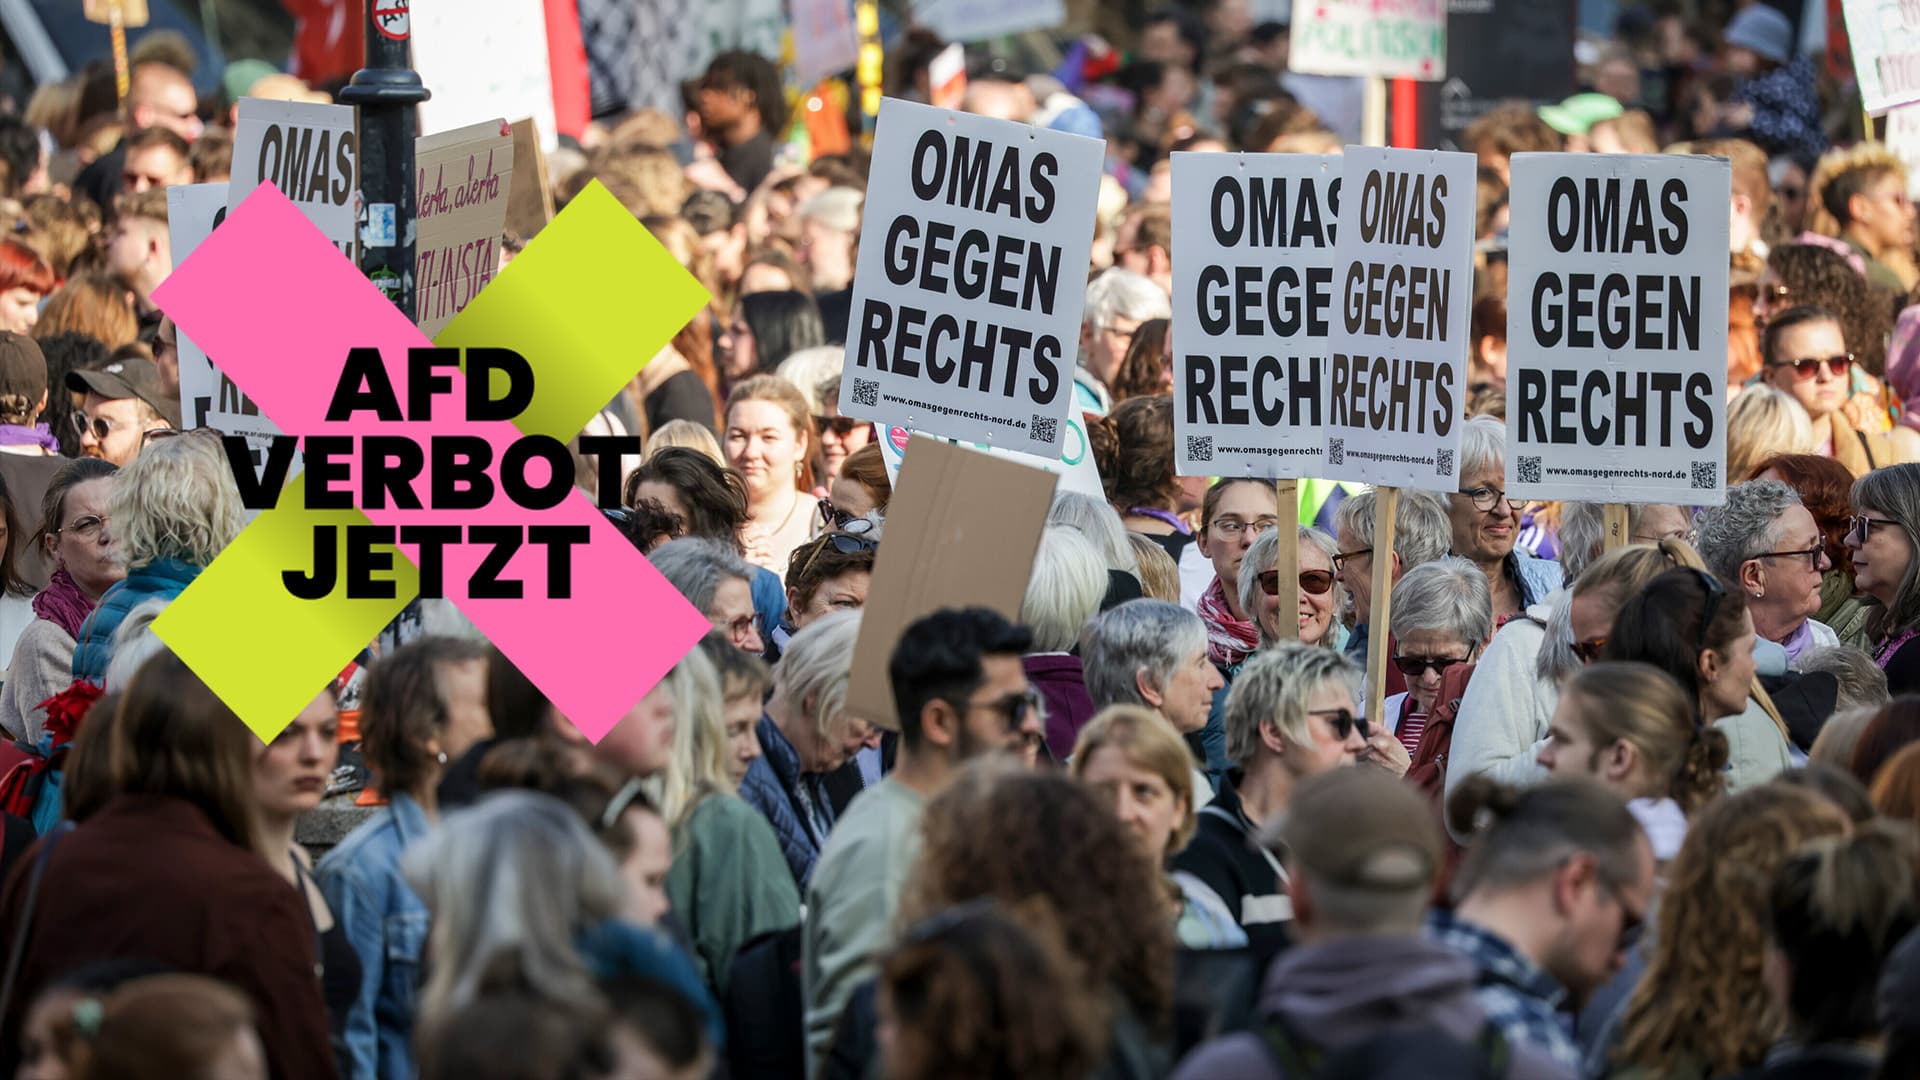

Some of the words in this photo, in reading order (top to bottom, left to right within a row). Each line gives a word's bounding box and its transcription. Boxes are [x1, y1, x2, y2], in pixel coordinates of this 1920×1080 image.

[257, 124, 355, 206] OMAS
[416, 164, 453, 220] lerta,
[454, 149, 500, 209] alerta
[911, 129, 1058, 223] OMAS
[1360, 169, 1448, 249] OMAS
[1548, 177, 1689, 256] OMAS
[416, 238, 494, 323] TI-INSTA
[884, 215, 1062, 315] GEGEN
[1197, 265, 1333, 337] GEGE
[1344, 261, 1451, 341] GEGEN
[1532, 272, 1701, 350] GEGEN
[856, 299, 1062, 405] RECHTS
[1185, 355, 1326, 427] RECH
[882, 393, 1027, 430] www.omasgegenrechts-nord.de
[1330, 353, 1454, 437] RECHTS
[1518, 369, 1714, 450] RECHTS
[1217, 444, 1323, 457] www.omasgegenrecht
[1346, 450, 1435, 466] www.omasgegenrechts-nord.de
[1546, 466, 1687, 480] www.omasgegenrechts-nord.de
